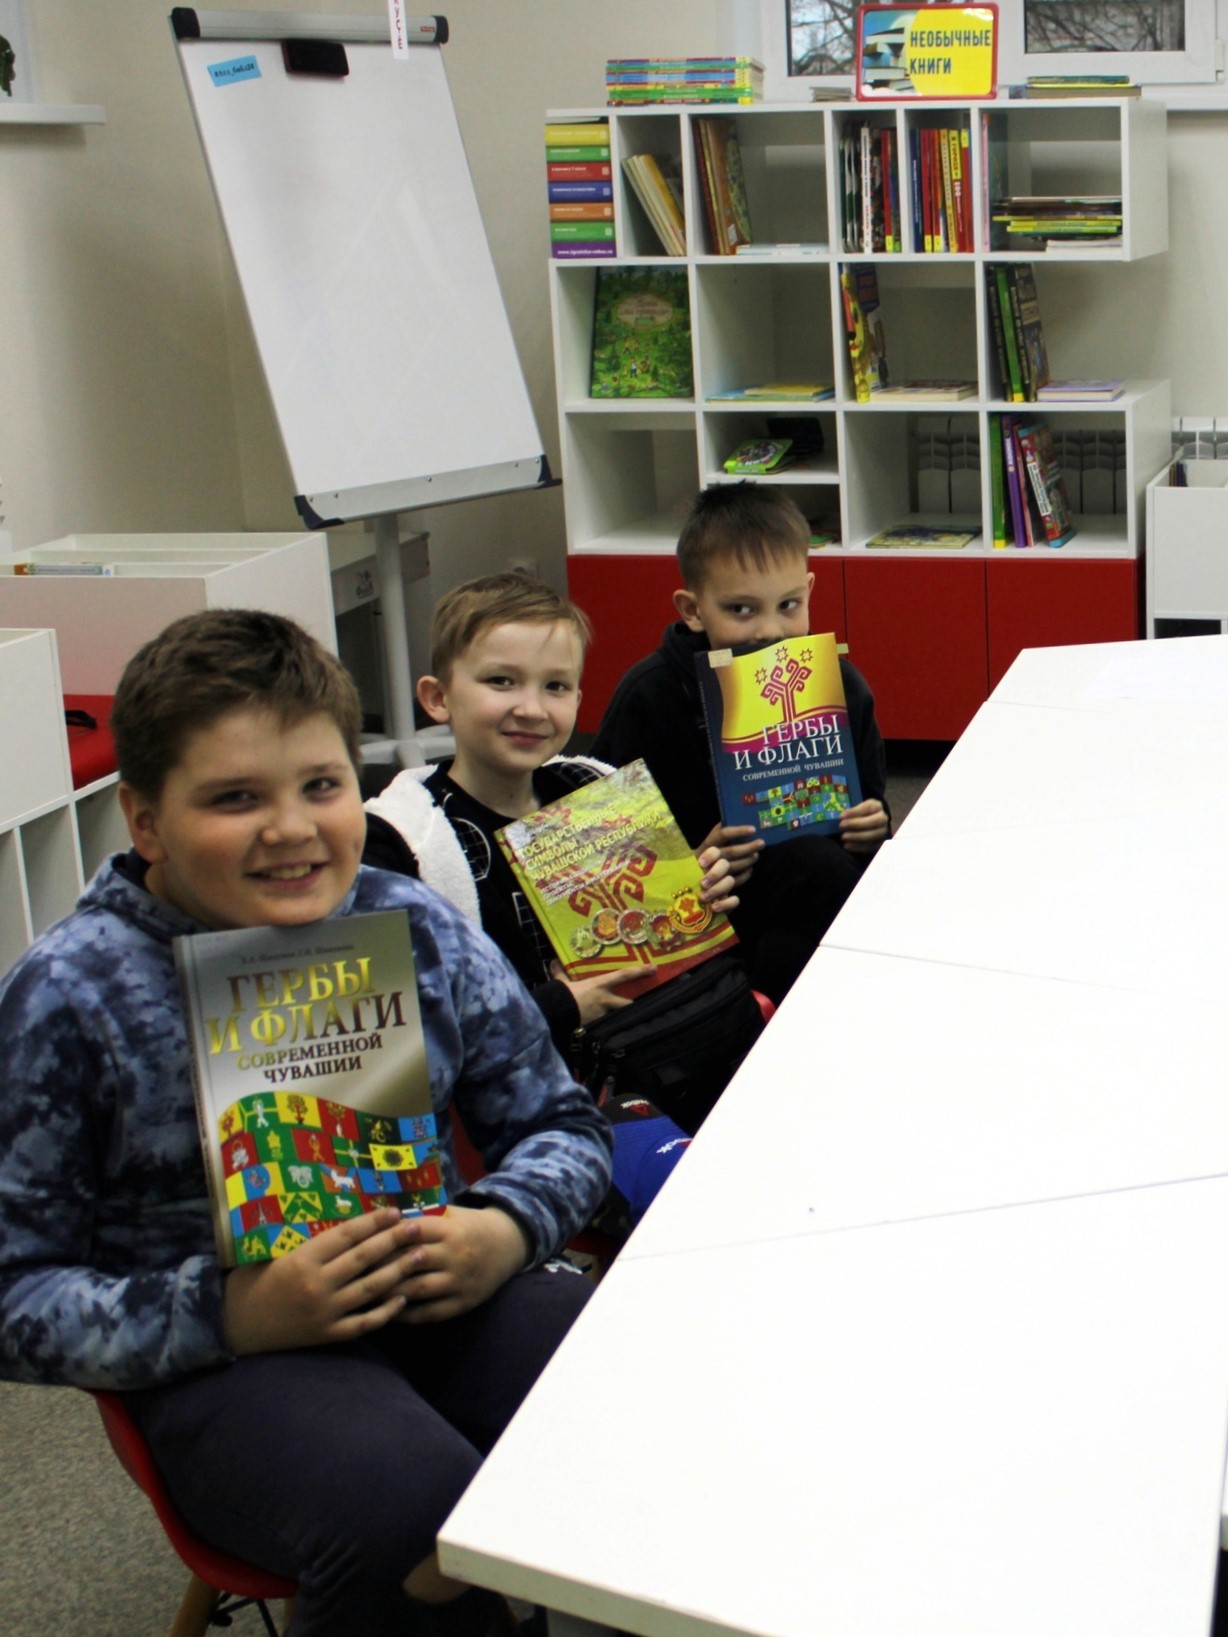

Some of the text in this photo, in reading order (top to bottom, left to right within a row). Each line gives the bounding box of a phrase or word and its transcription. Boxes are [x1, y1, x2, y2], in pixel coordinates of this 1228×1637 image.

[910, 30, 992, 48] НЕОБЫЧНЫЕ
[910, 57, 952, 74] КНИГИ
[762, 714, 840, 745] ГЕРБЫ
[734, 734, 844, 770] И ФЛАГИ
[742, 758, 844, 782] СОВРЕМЕННОЙ ЧУВАШИИ
[518, 803, 619, 858] ГОСУДАРСТВЕННЫЕ
[532, 842, 596, 881] ЧУВАШСКОЙ
[595, 811, 662, 850] РЕСПУБЛИКИ
[524, 840, 578, 870] СИМВОЛЫ
[226, 957, 375, 1012] ГЕРБЫ
[207, 990, 408, 1056] И ФЛАГИ
[236, 1032, 383, 1070] СОВРЕМЕННОЙ
[264, 1055, 363, 1084] ЧУВАШИИ
